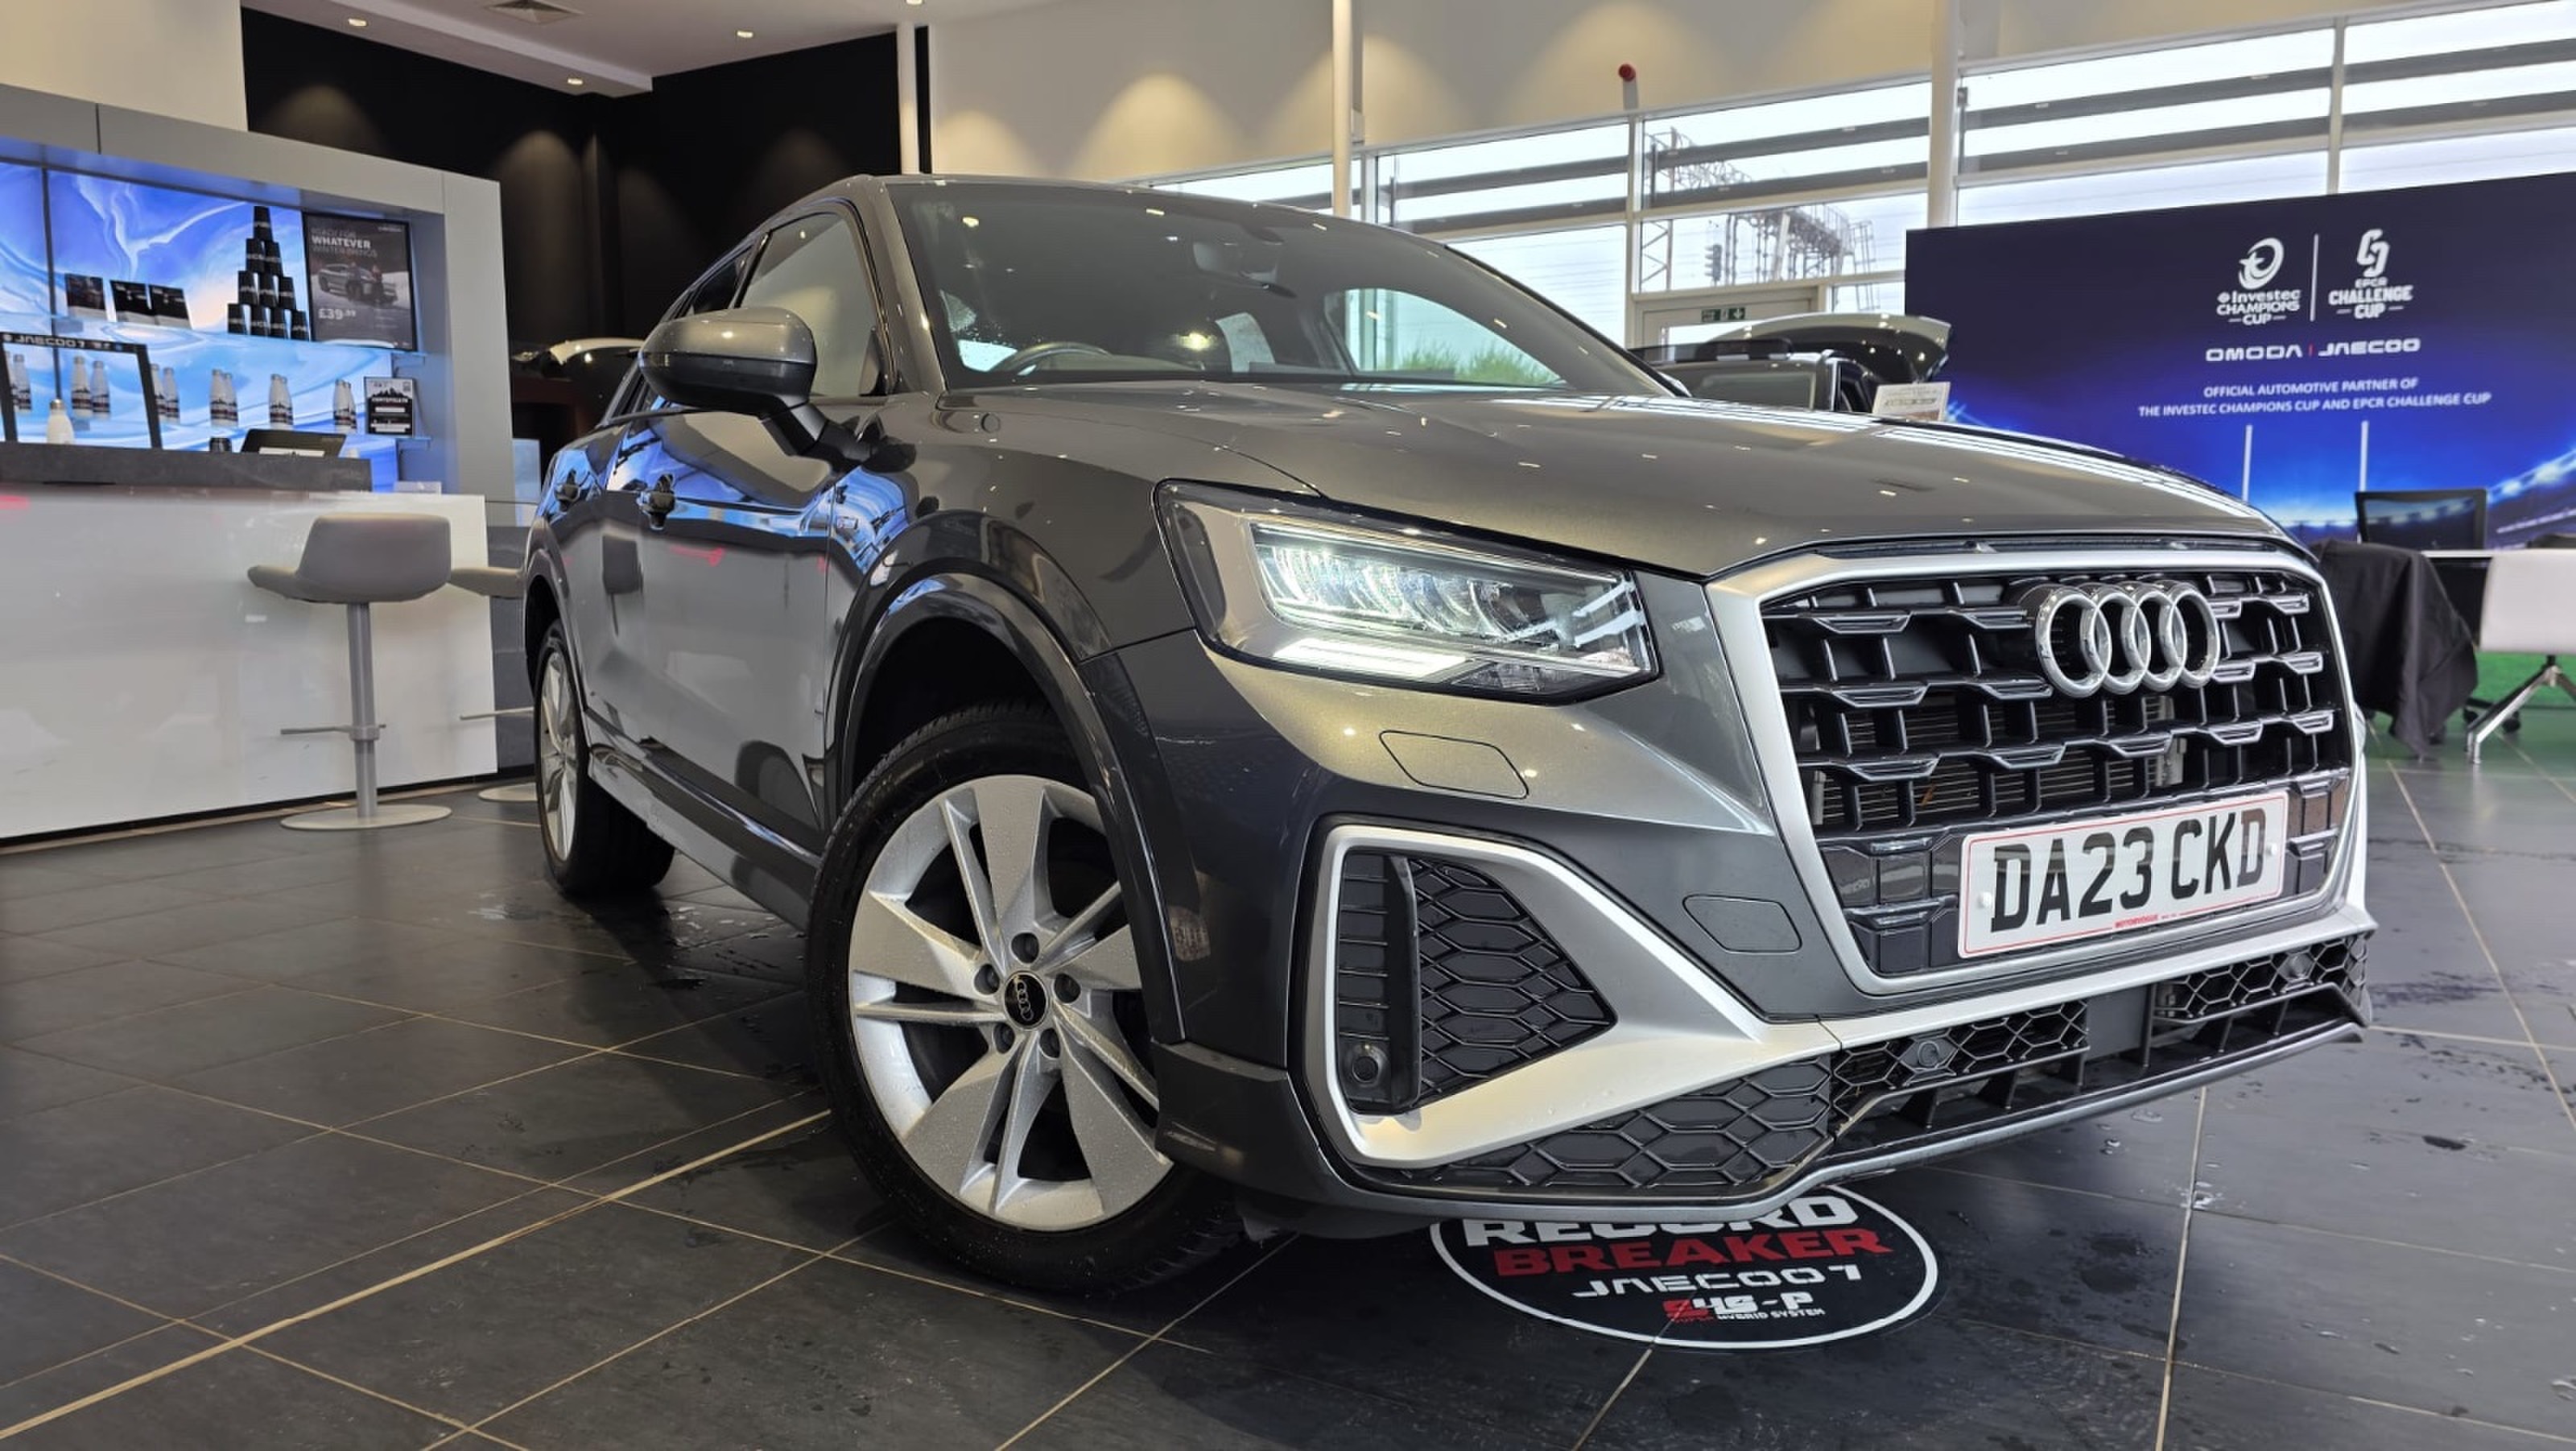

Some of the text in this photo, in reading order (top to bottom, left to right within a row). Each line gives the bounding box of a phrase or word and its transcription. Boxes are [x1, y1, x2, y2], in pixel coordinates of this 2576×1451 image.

[312, 235, 371, 249] WHATEVER
[2355, 277, 2388, 289] EPCR
[2232, 289, 2301, 304] Investec
[2328, 285, 2414, 305] CHALLENGE
[2216, 301, 2301, 316] CHAMPIONS
[2354, 303, 2386, 319] CUP
[2242, 313, 2273, 325] CUP
[2206, 338, 2421, 362] OMODA JAECOO
[2203, 377, 2418, 399] OFFICIAL AUTOMOTIVE PARTNER OF
[2138, 391, 2491, 417] THE INVESTEC CHAMPIONS CUP AND EPCR CHALLENGE CUP
[1991, 808, 2266, 932] DA23 CKD
[1493, 1228, 1893, 1277] BREAKER
[1717, 1308, 1826, 1321] HYBRID SYSTEM
